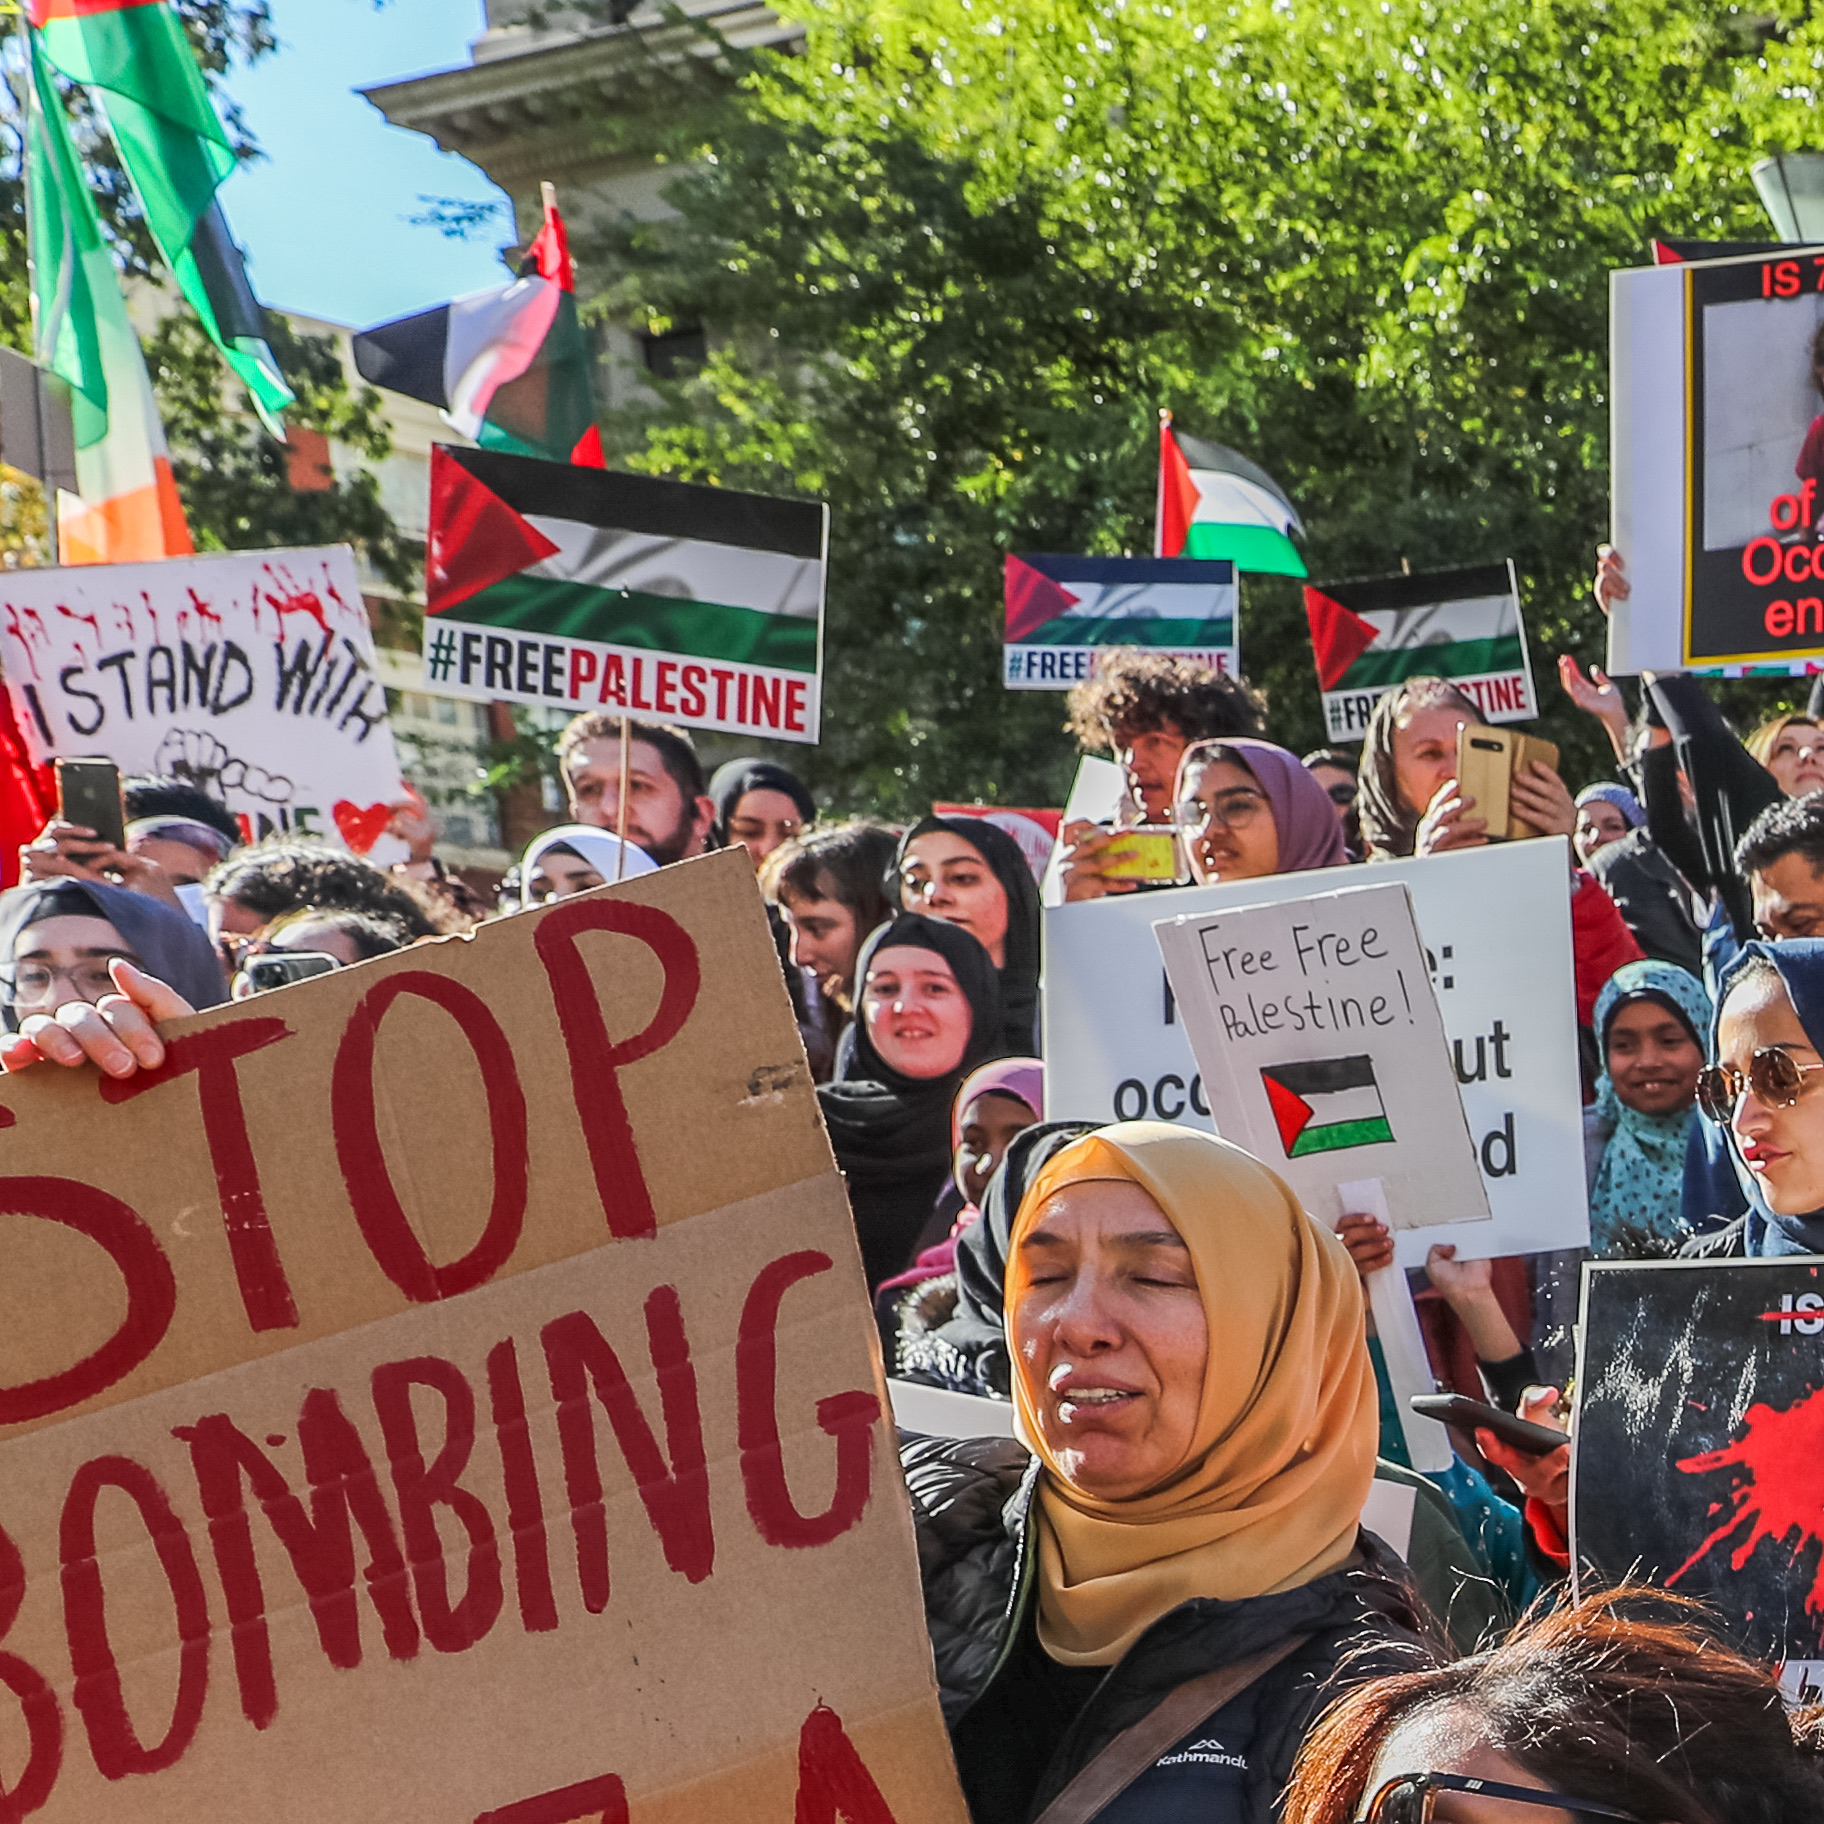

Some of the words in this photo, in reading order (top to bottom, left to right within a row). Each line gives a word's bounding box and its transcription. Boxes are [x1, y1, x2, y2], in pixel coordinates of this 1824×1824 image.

[1762, 259, 1801, 298] IS
[1769, 477, 1819, 531] of
[23, 684, 54, 748] I
[60, 639, 254, 736] STAND
[274, 629, 388, 744] WITH
[427, 627, 807, 735] #FREEPALESTINE
[1197, 925, 1280, 996] Free
[1290, 922, 1390, 977] Free
[1218, 970, 1416, 1042] Palestine!
